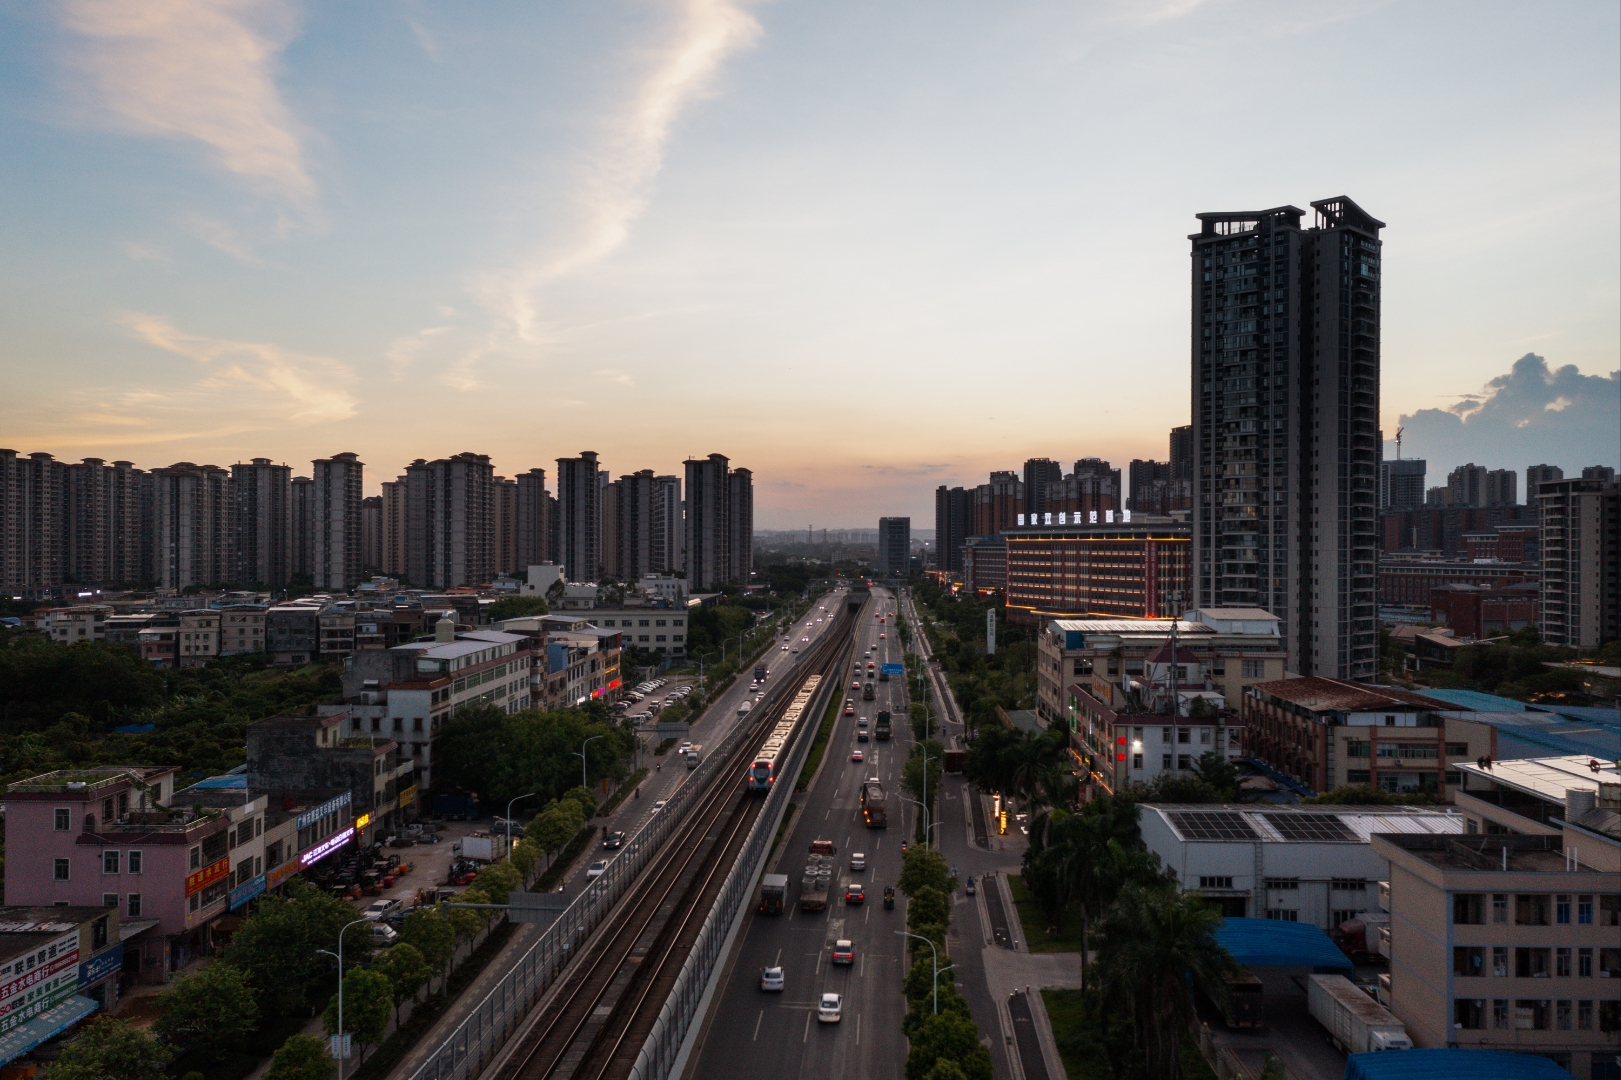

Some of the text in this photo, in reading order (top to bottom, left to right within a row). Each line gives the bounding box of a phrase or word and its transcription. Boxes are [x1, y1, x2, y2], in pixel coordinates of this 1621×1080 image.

[1017, 509, 1131, 526] 国家双创示范基地
[14, 944, 57, 975] 联塑管道
[1, 965, 50, 999] 五金水电商行
[1, 996, 50, 1032] 五金水电商行
